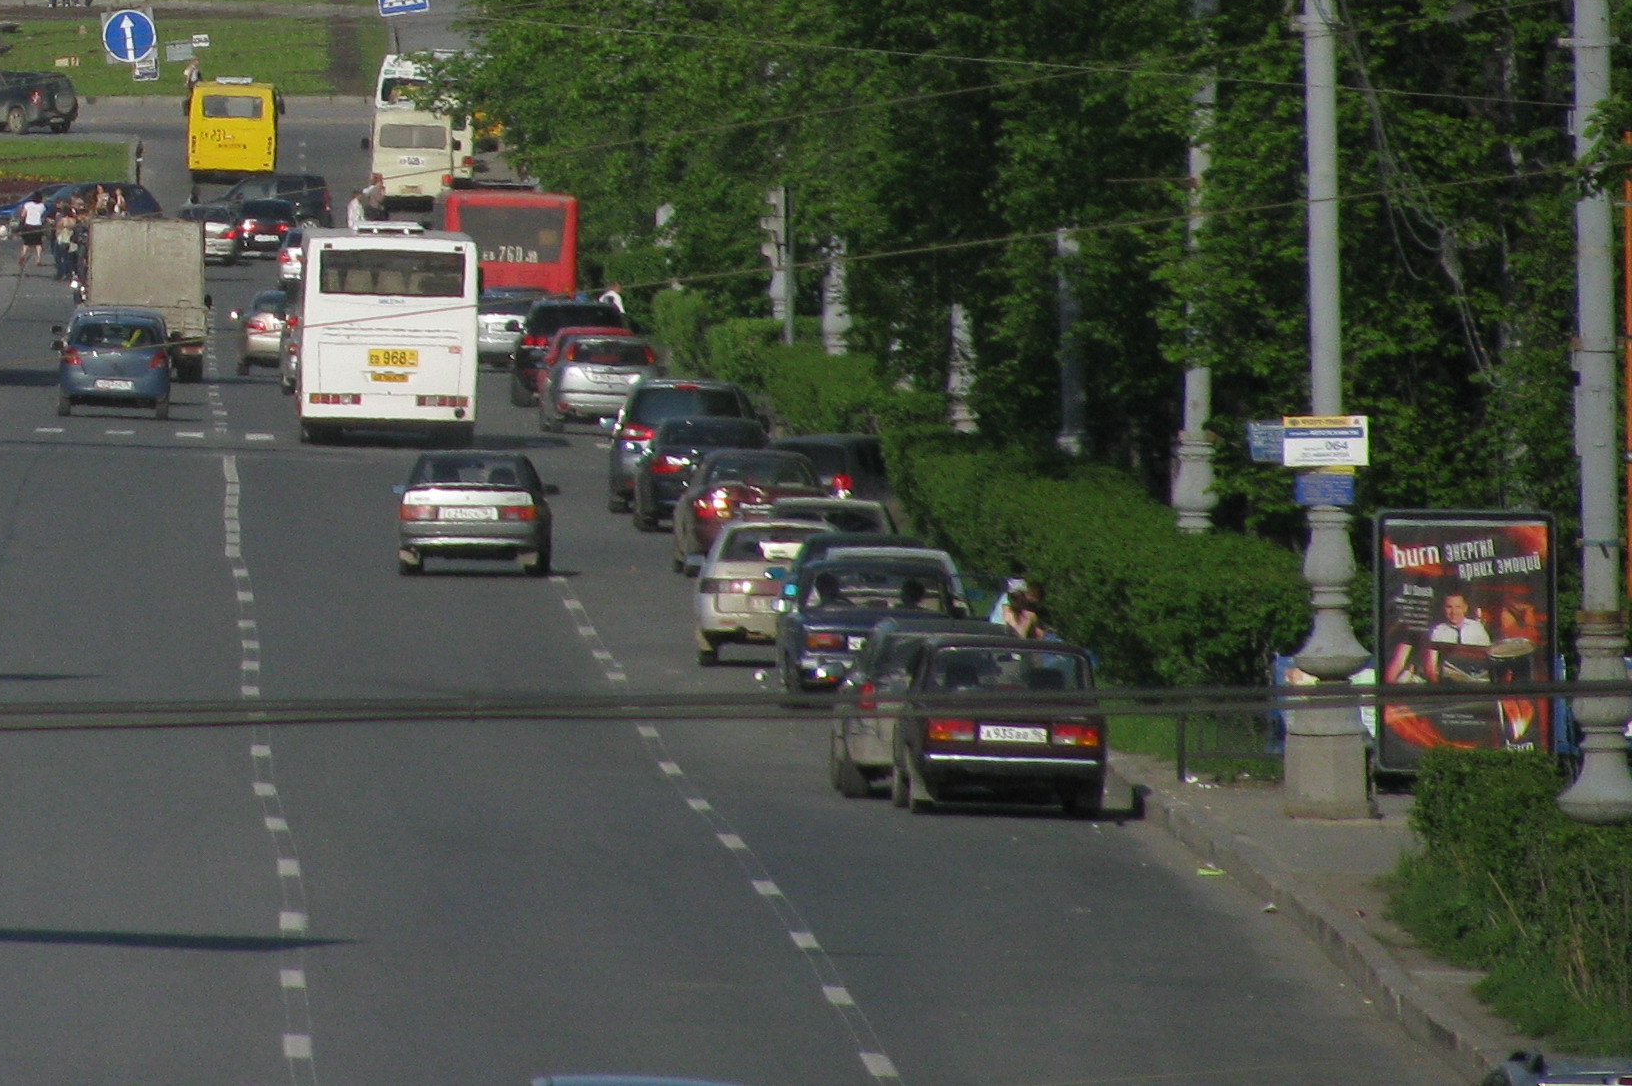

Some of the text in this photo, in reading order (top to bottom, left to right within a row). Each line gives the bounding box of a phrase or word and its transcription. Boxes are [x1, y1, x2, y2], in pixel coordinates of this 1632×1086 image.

[383, 350, 407, 365] 968
[1392, 543, 1441, 569] burn
[1444, 539, 1496, 562] ЭНЕРГИЯ
